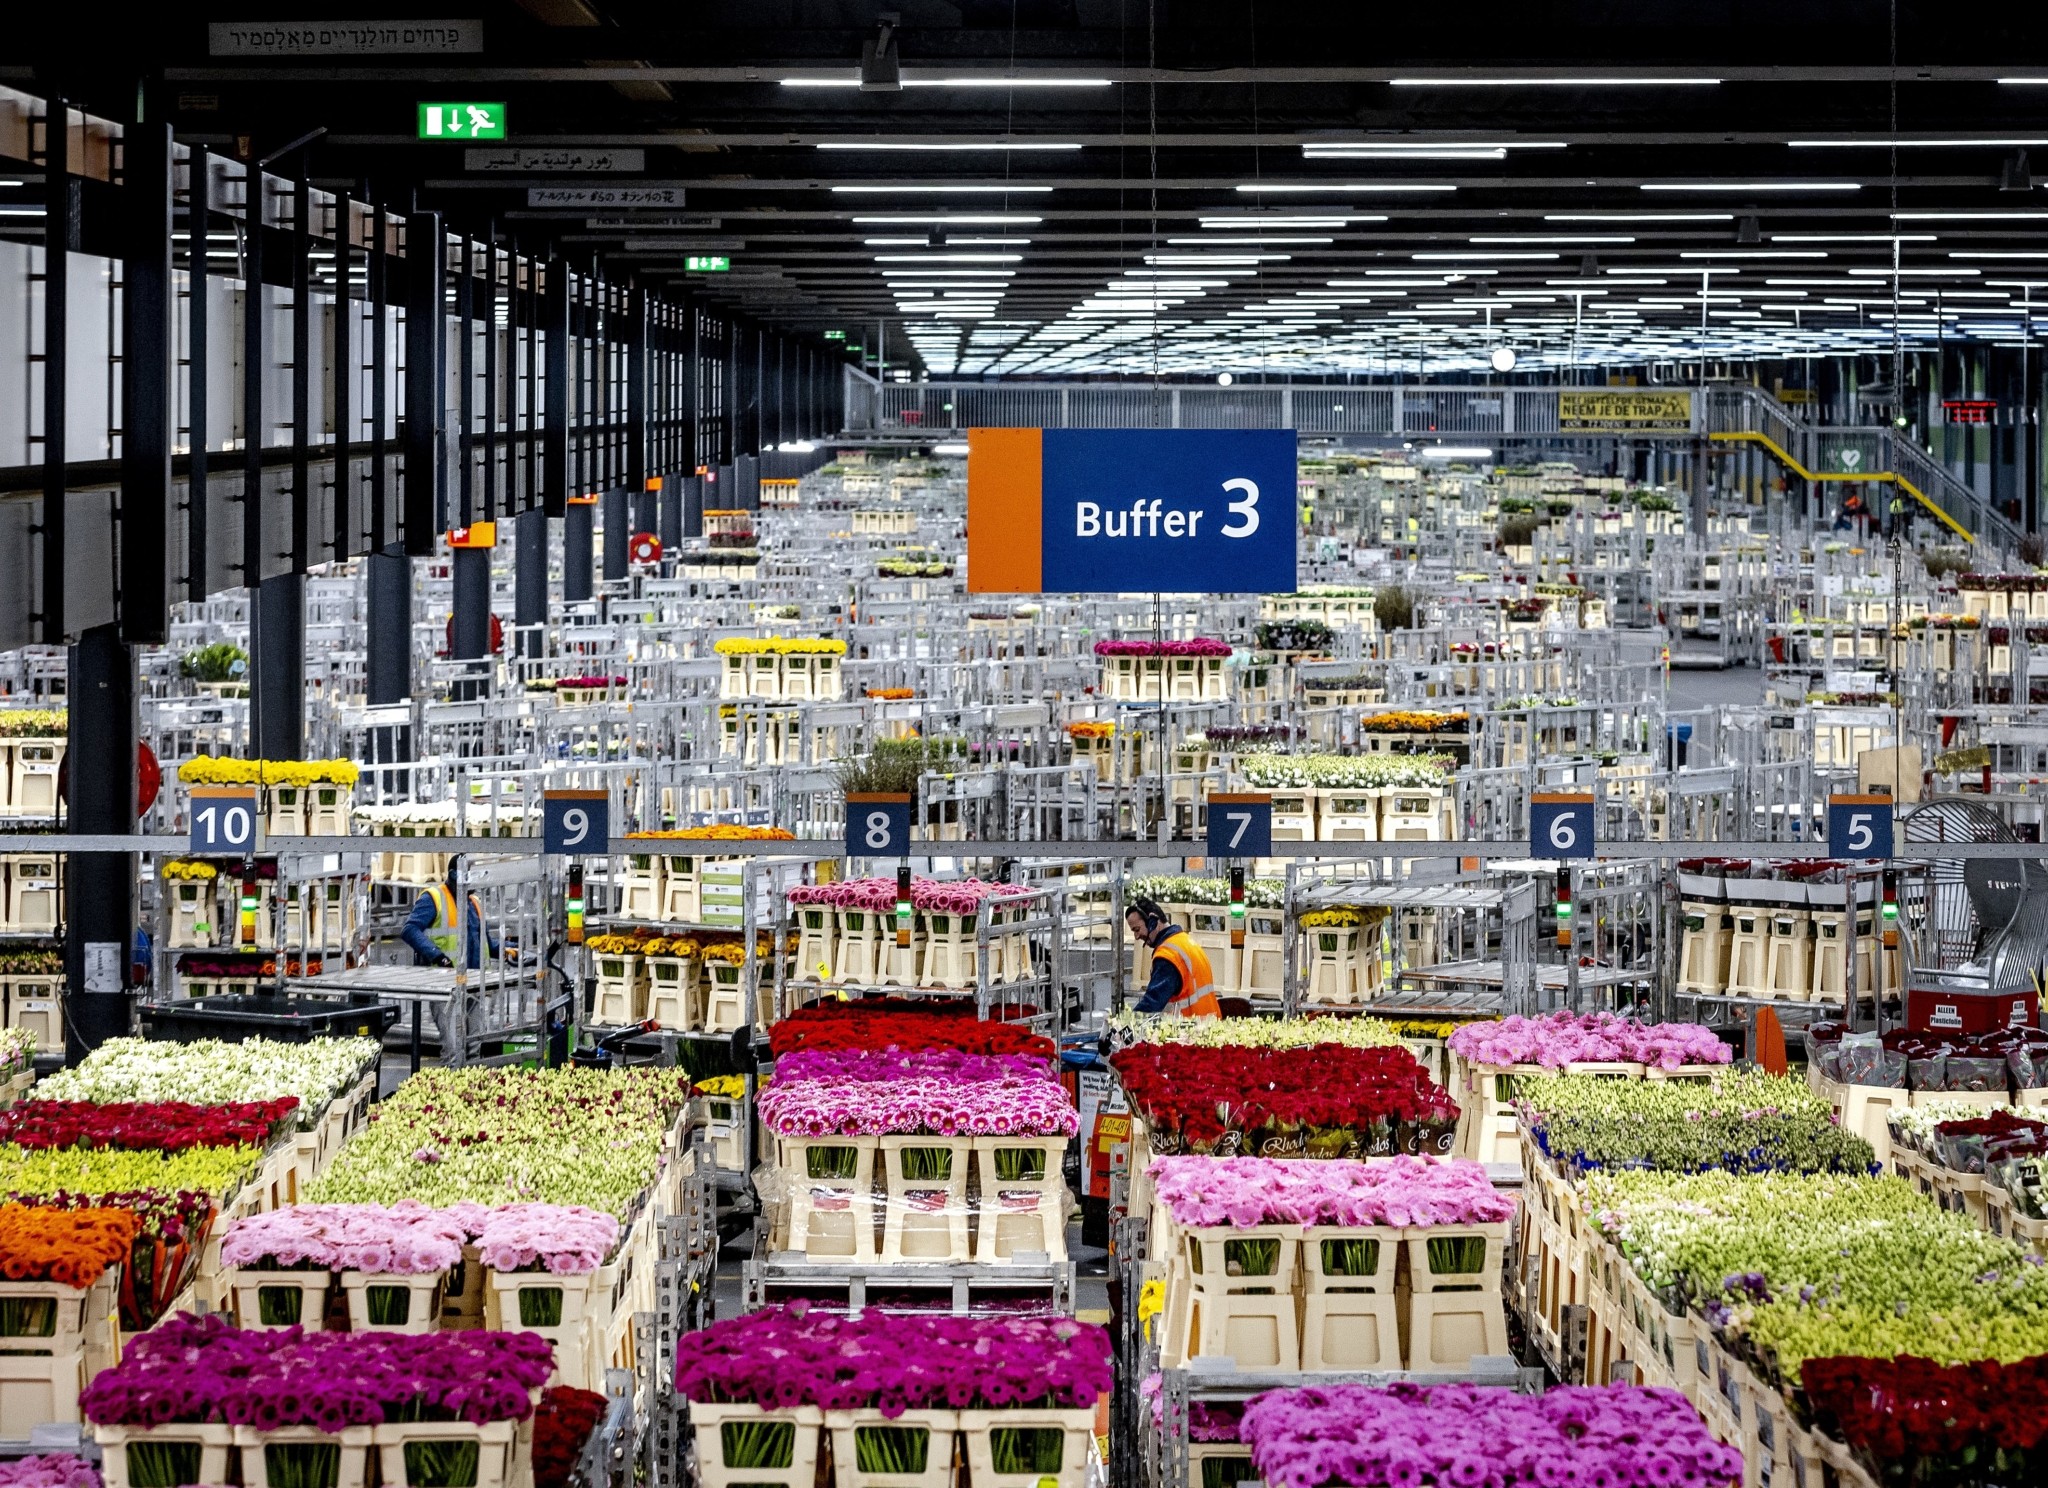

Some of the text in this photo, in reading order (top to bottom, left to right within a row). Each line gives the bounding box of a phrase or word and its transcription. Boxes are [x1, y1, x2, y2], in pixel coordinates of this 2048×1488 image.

[1563, 405, 1662, 416] NEEM JE DE TRAP
[1077, 478, 1260, 538] Buffer 3
[195, 807, 250, 845] 10
[563, 809, 589, 845] 9
[866, 812, 891, 849] 8
[1227, 813, 1252, 848] 7
[1549, 812, 1576, 849] 6
[1848, 814, 1873, 851] 5
[1937, 1006, 1955, 1014] ALLEEN
